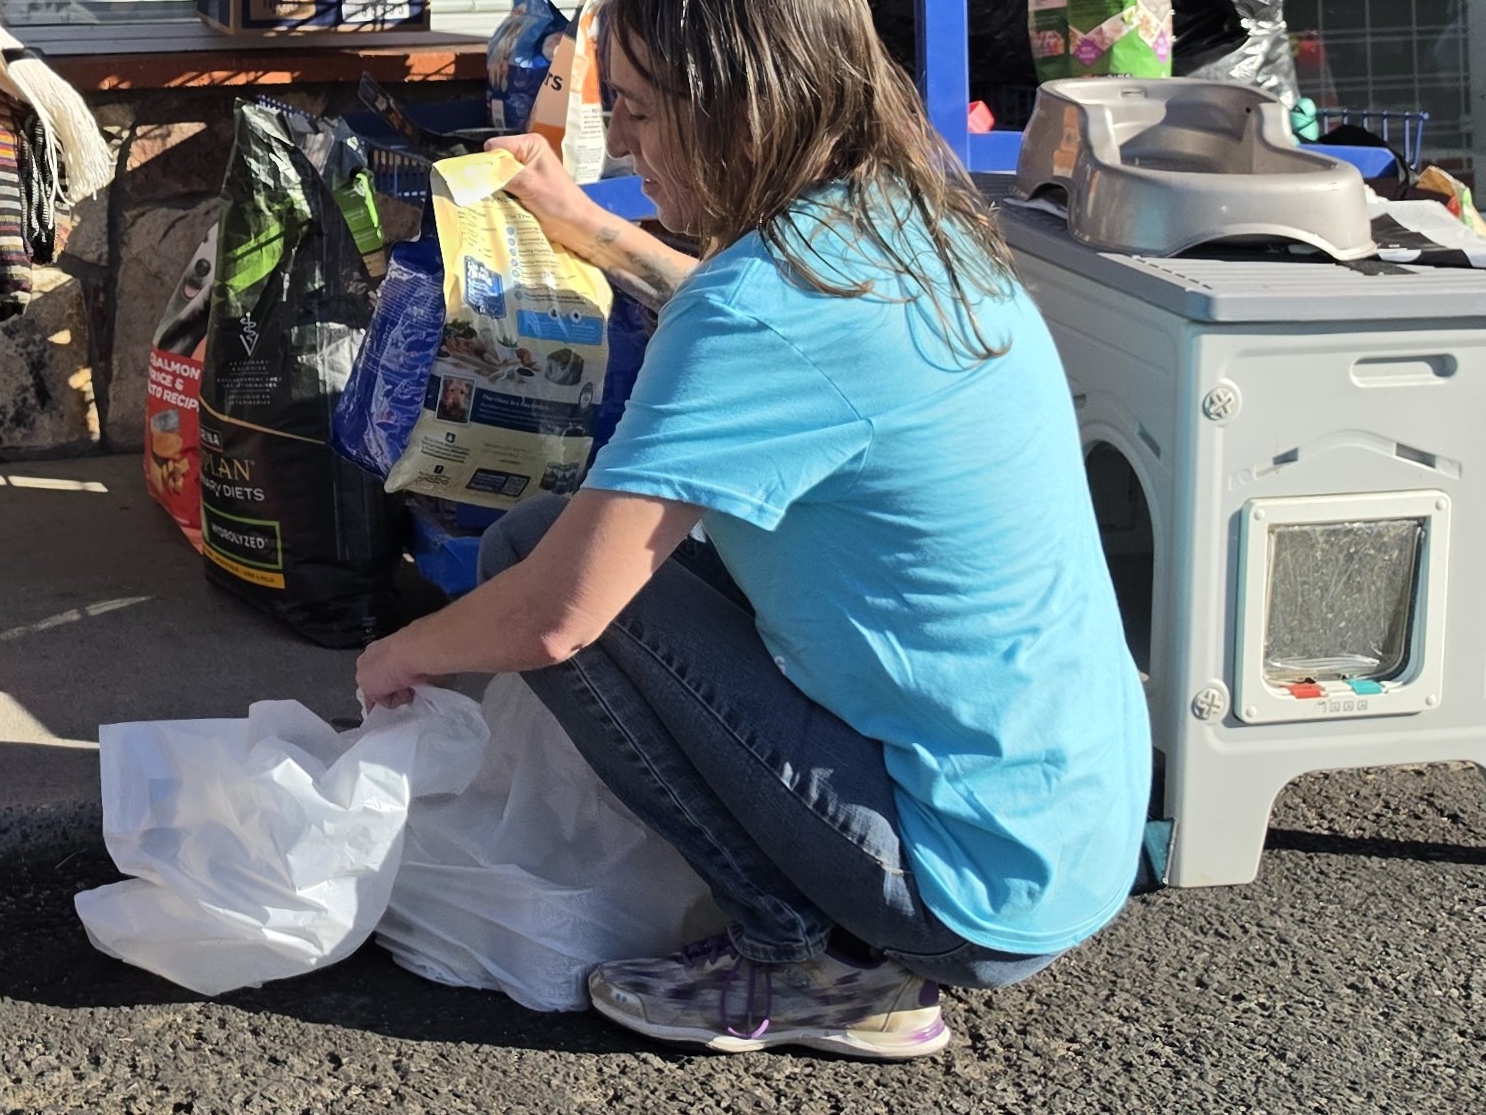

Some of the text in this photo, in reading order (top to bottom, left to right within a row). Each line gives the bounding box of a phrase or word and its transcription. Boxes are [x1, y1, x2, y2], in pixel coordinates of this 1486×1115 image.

[149, 366, 184, 391] RICE &
[150, 353, 201, 380] SALMON
[223, 483, 265, 502] DIETS
